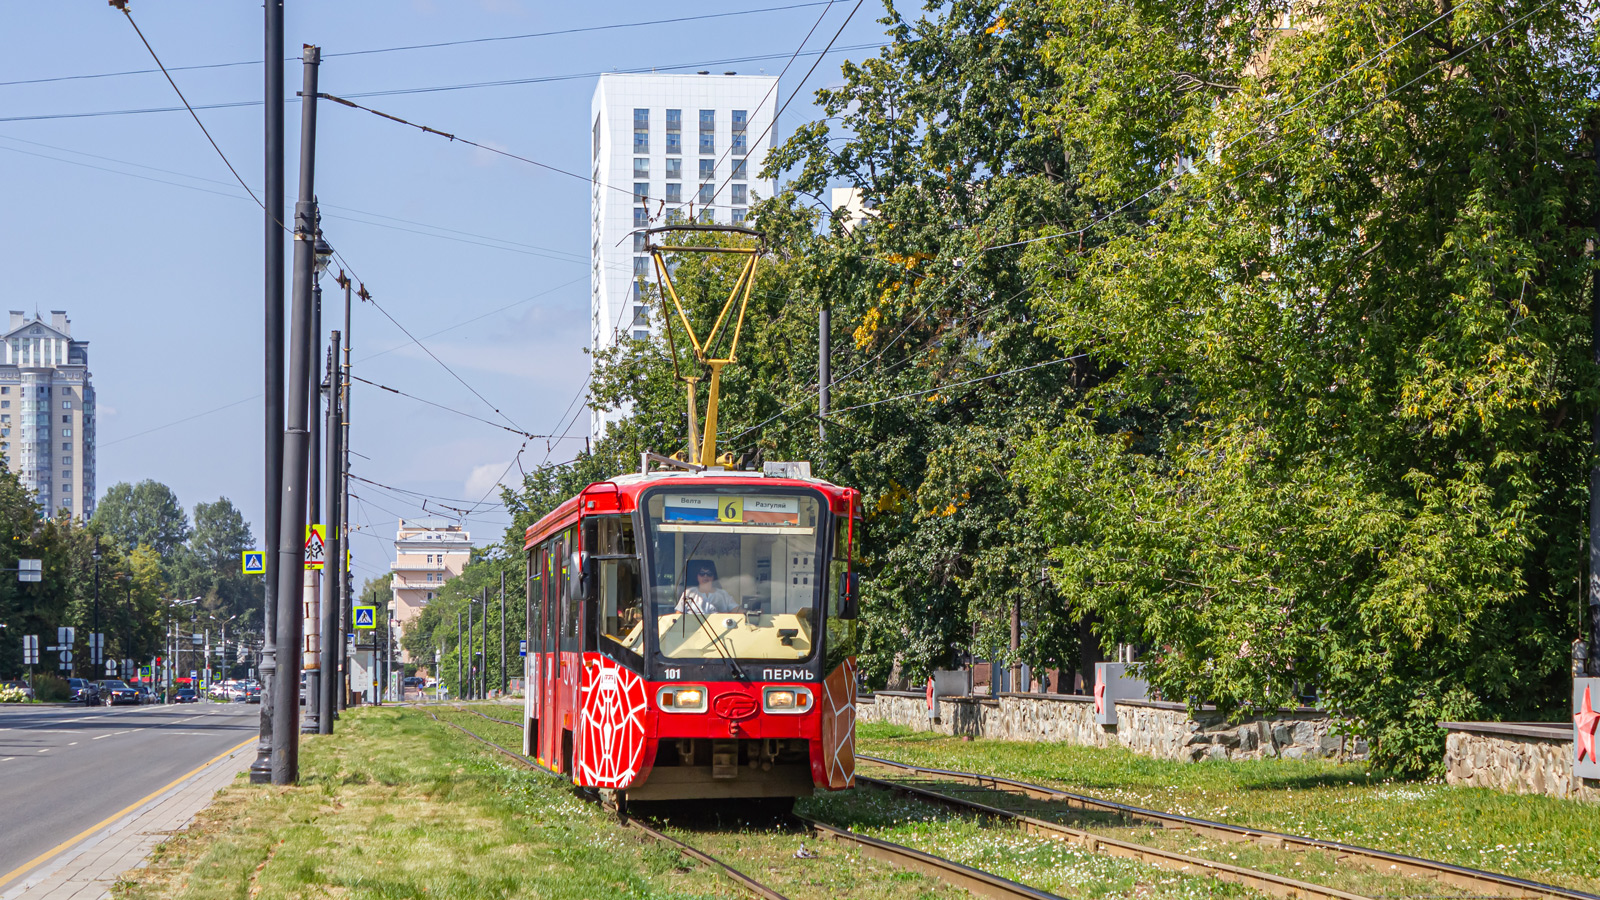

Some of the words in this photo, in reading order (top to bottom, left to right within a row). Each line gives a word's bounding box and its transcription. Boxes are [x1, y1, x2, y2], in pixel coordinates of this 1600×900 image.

[724, 502, 736, 519] 6
[664, 669, 680, 679] 101
[762, 669, 814, 680] ПЕРМЬ
